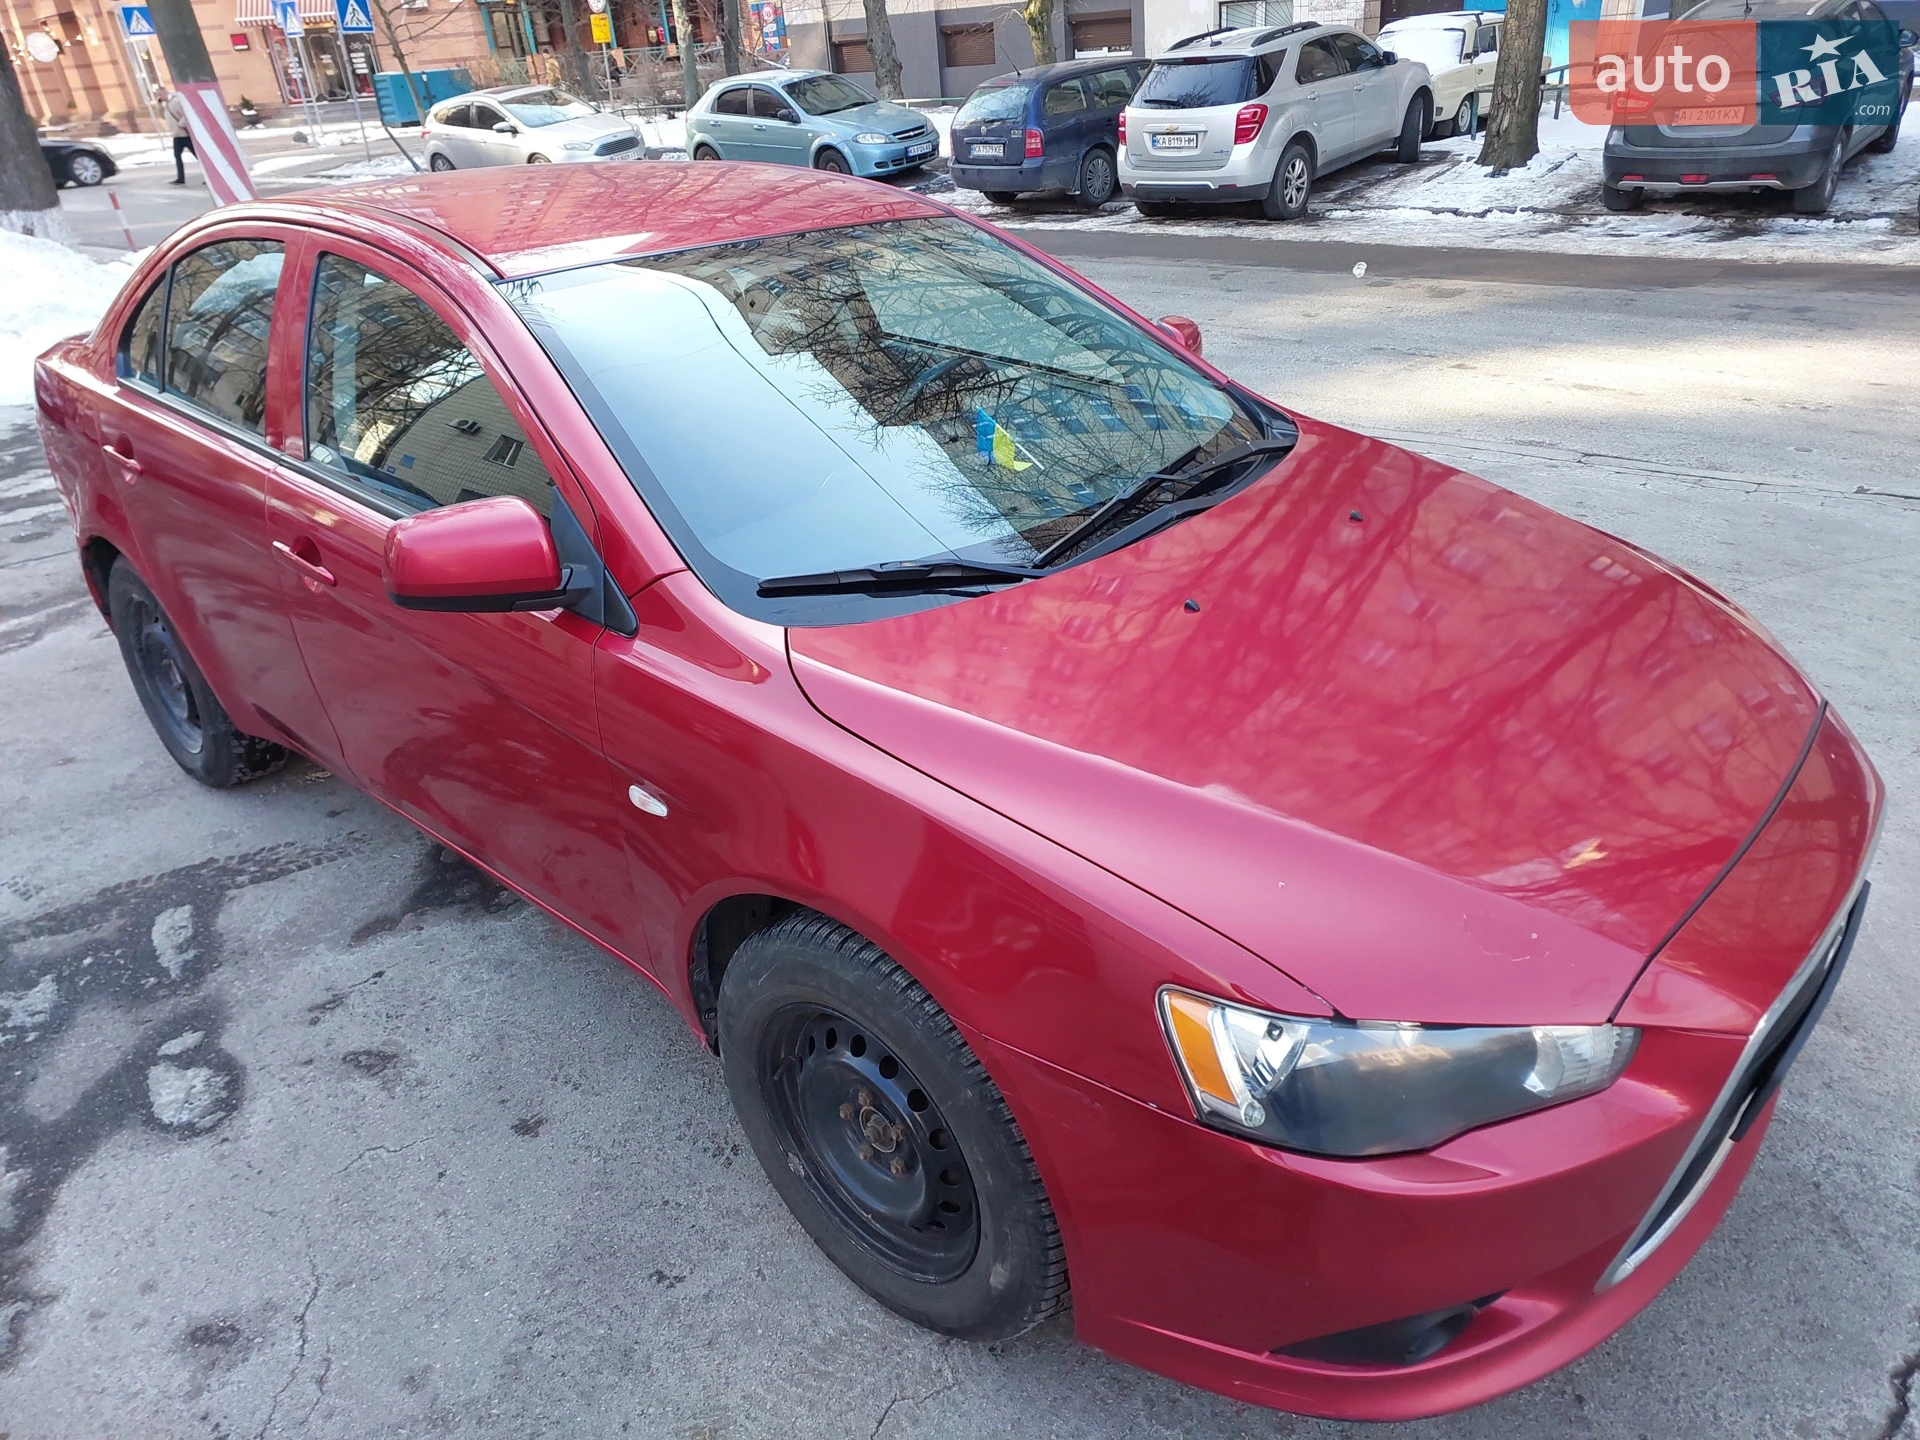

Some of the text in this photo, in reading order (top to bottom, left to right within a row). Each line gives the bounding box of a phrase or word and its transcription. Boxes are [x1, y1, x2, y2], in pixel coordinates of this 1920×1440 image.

[1696, 110, 1722, 121] 2101
[1724, 109, 1741, 120] KX
[1157, 137, 1195, 145] KA 8119 HM
